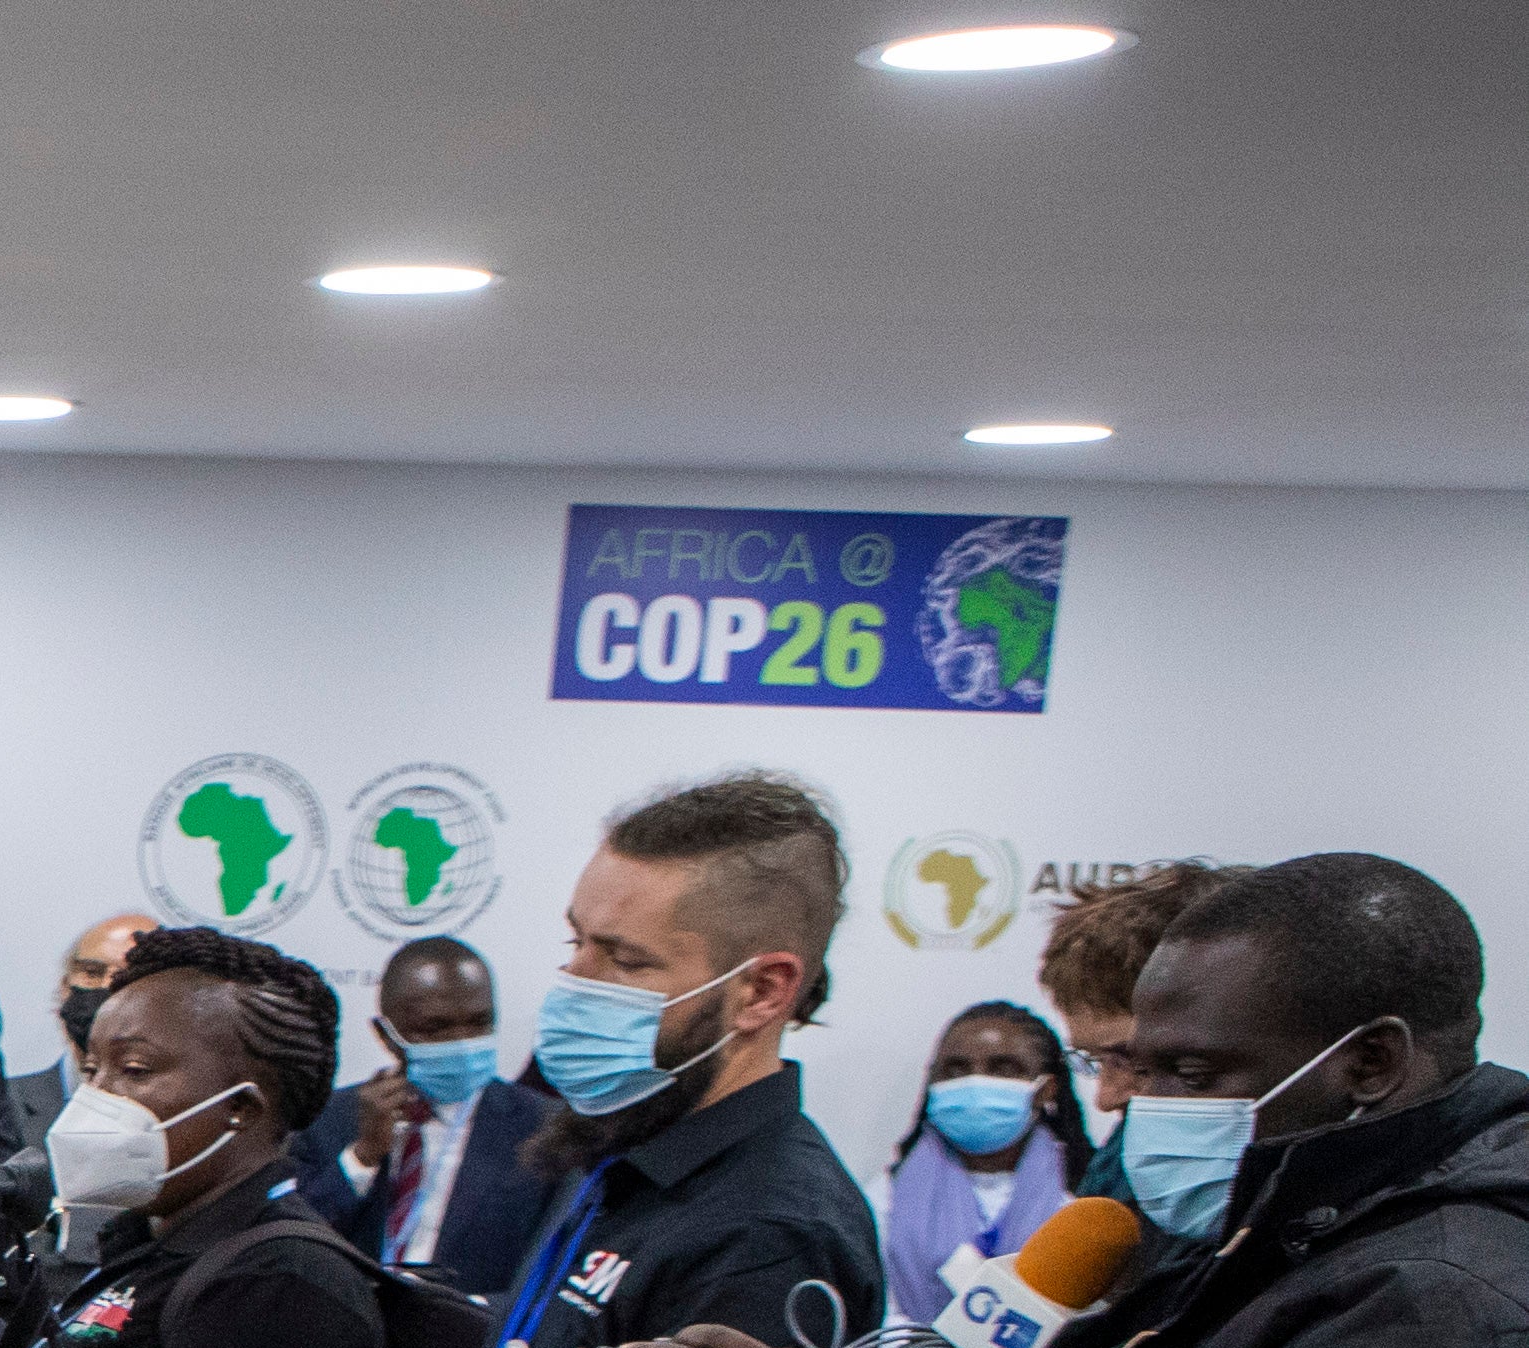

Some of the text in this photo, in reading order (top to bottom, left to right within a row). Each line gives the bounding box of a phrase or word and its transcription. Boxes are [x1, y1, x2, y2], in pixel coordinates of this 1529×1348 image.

[585, 528, 896, 588] AFRICA @
[575, 591, 886, 690] COP26
